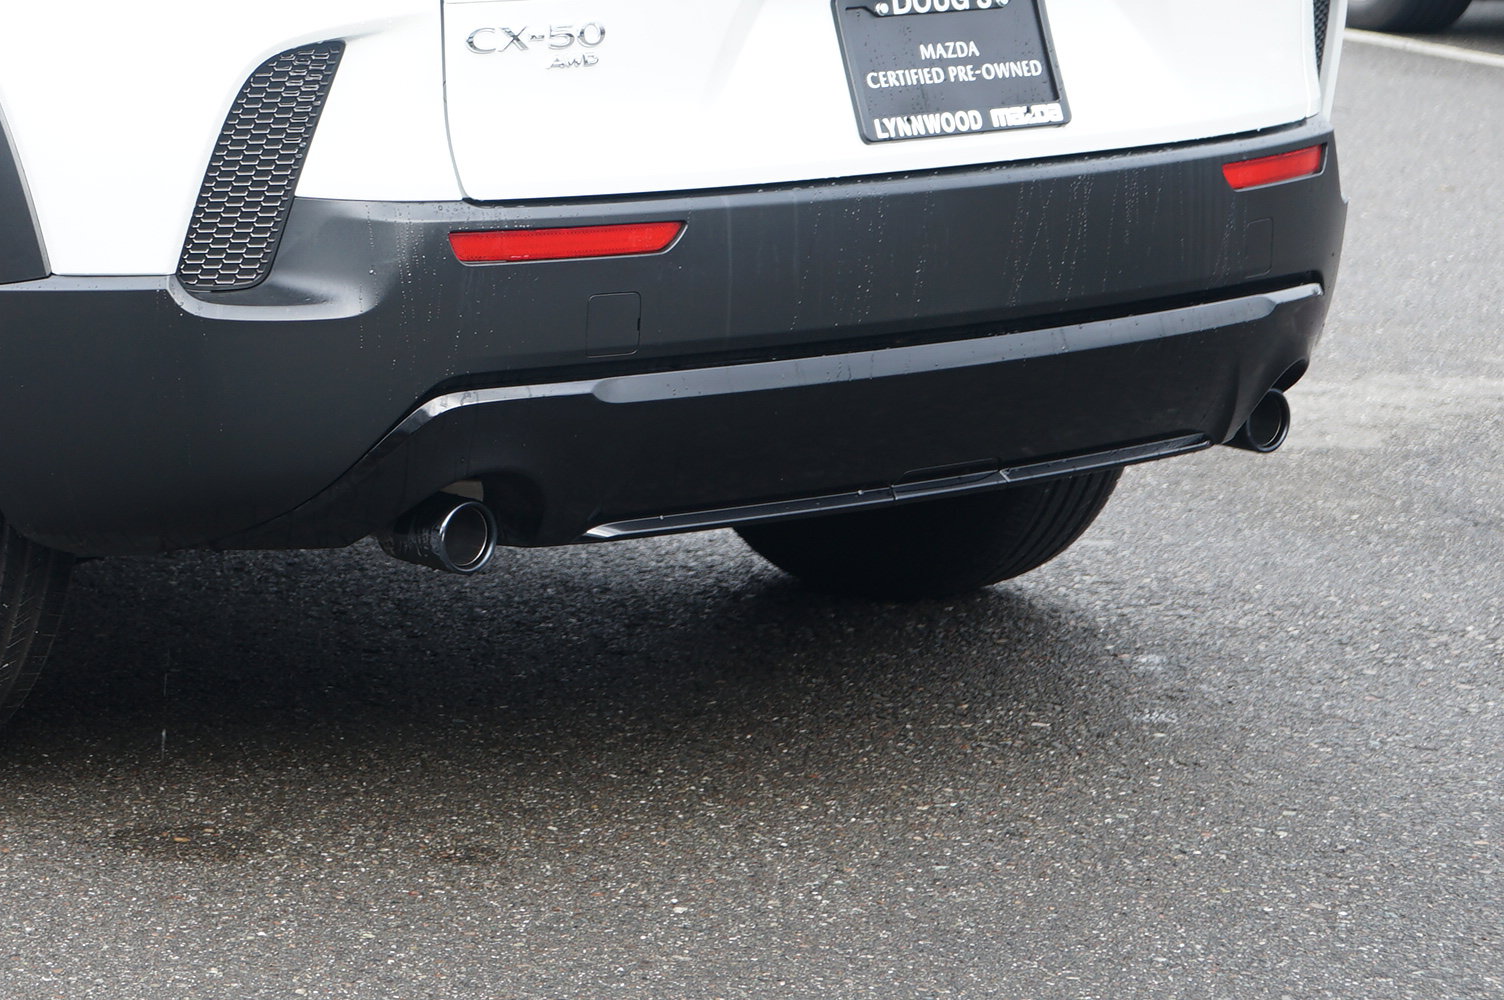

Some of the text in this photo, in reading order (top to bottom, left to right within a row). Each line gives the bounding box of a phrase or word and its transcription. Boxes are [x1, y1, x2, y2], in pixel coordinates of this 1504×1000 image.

[465, 22, 606, 54] CX-50
[919, 40, 979, 60] MAZDA
[866, 59, 1043, 89] CERTIFIED PRE-OWNED
[873, 110, 983, 139] LYNNWOOD
